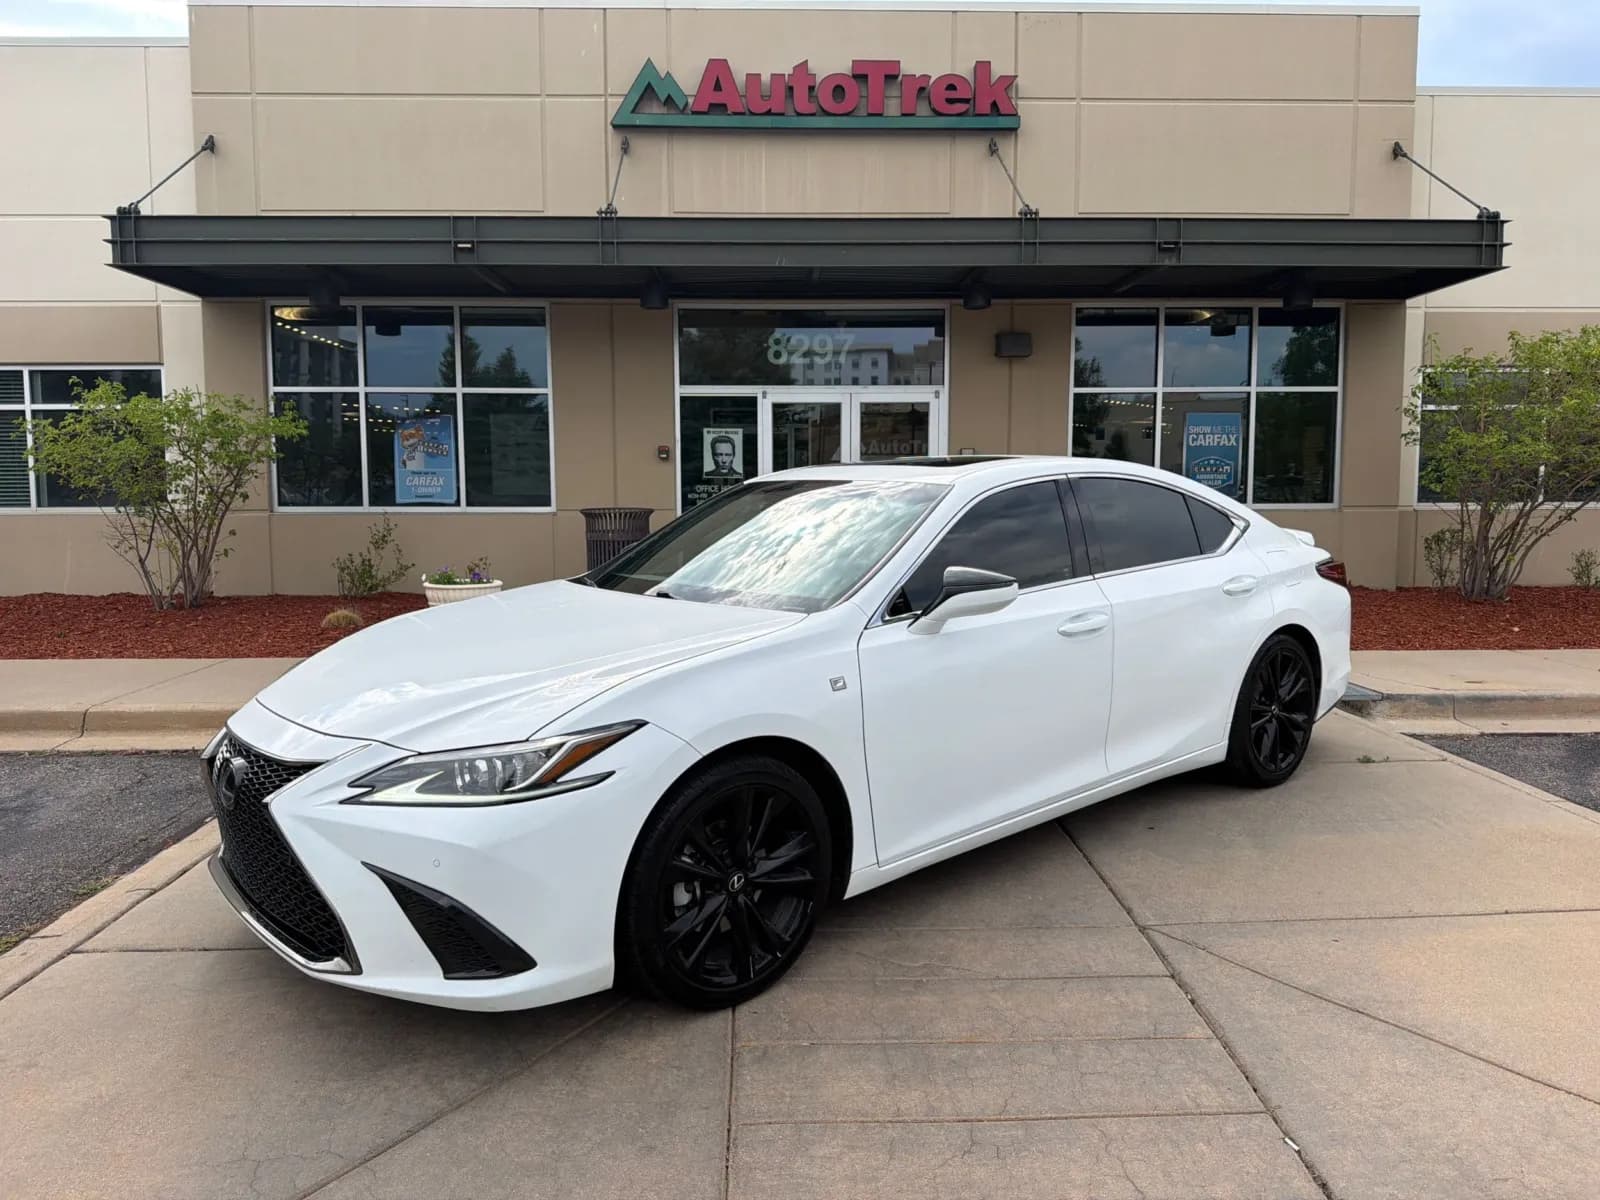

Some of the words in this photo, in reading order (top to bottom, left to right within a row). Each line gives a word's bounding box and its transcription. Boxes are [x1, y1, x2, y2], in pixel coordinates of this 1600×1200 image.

[690, 57, 1019, 116] AutoTrek
[767, 333, 855, 365] 8297
[1188, 426, 1211, 434] SHOW
[1188, 434, 1237, 447] CARFAX
[406, 476, 445, 486] CARFAX
[696, 484, 719, 493] OFFICE
